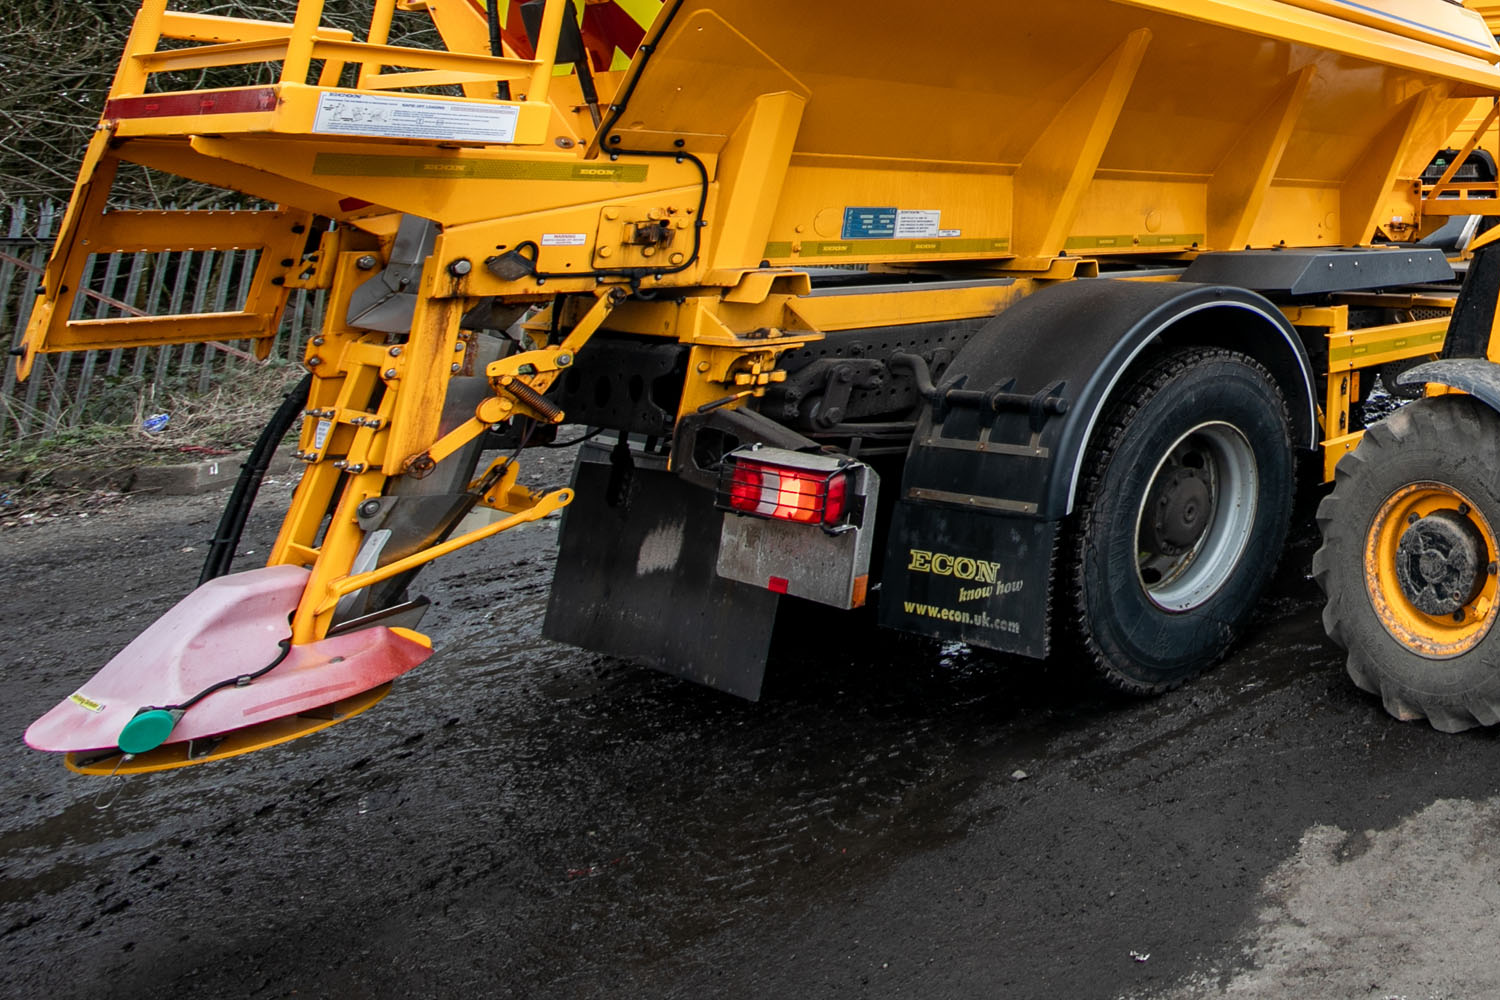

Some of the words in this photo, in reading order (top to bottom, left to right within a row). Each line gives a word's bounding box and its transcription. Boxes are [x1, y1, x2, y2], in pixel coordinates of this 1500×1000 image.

[907, 549, 1001, 583] ECON
[958, 585, 994, 602] know
[995, 580, 1024, 596] how
[903, 601, 1020, 634] www.econ.uk.com
